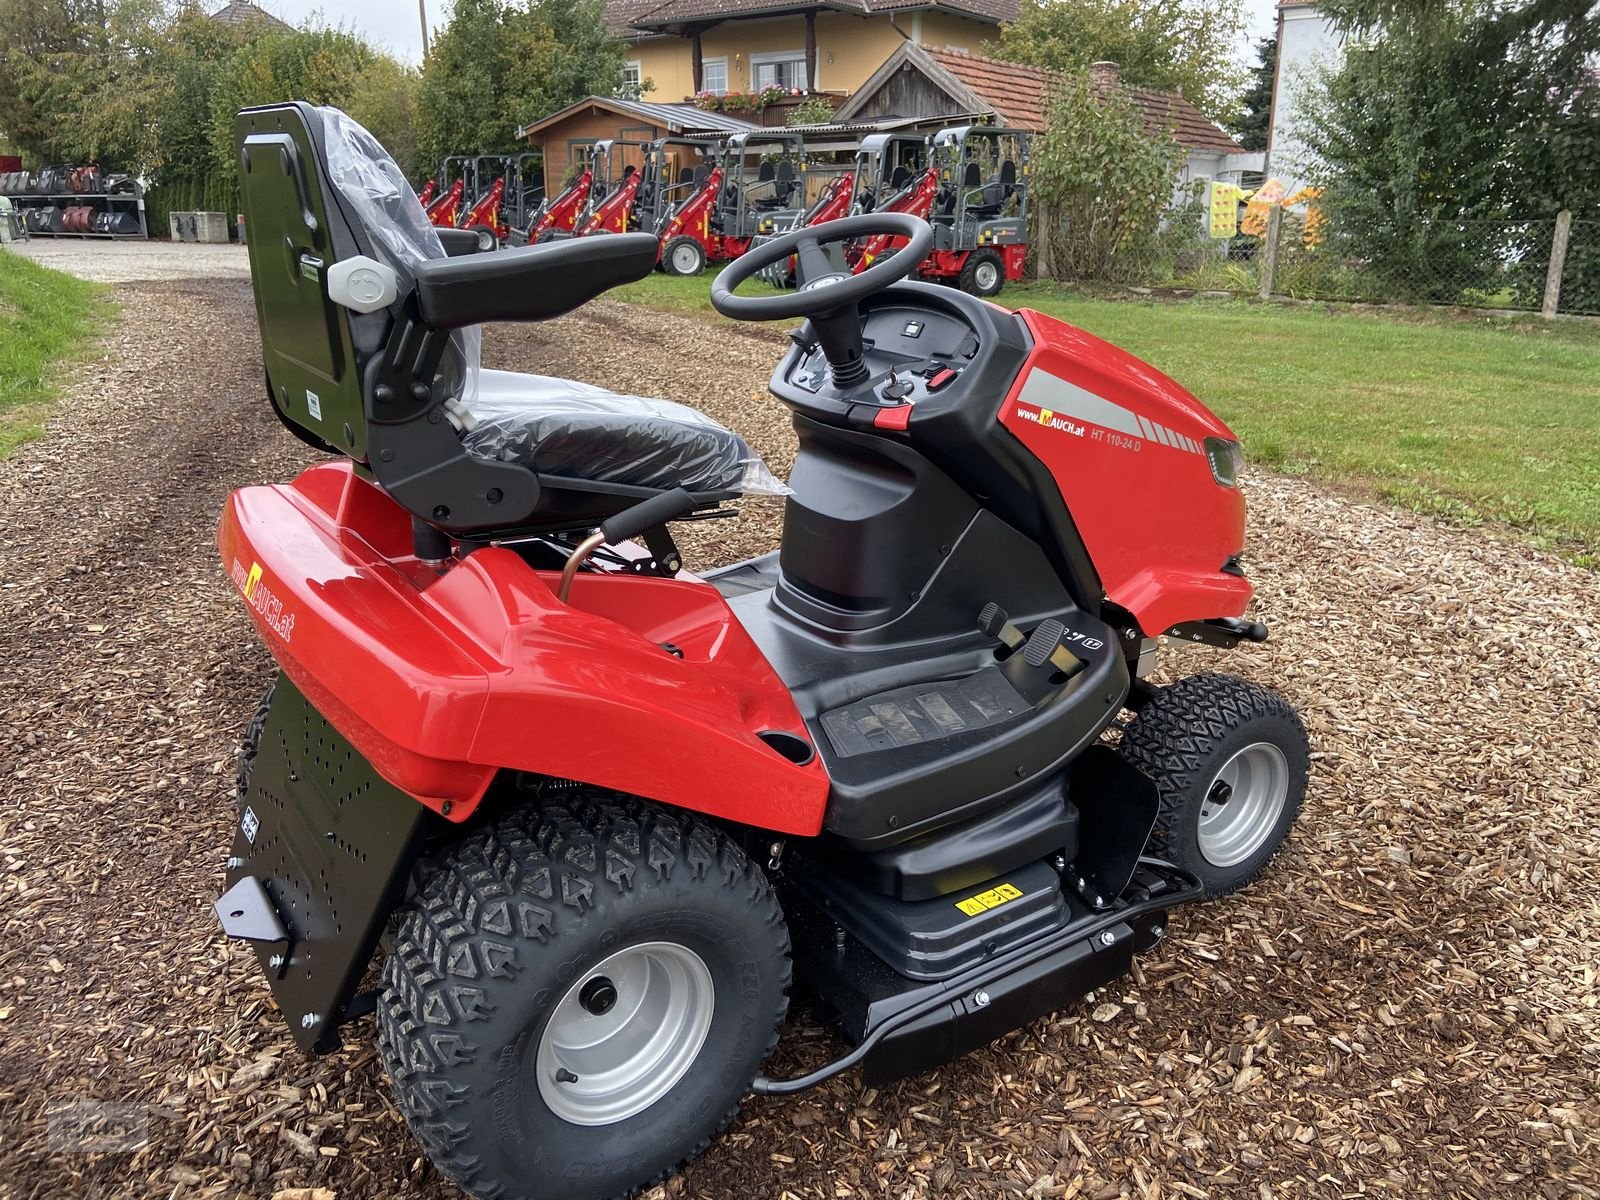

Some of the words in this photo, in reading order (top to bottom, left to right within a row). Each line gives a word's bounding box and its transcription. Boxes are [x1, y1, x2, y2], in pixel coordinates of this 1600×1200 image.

[1017, 408, 1085, 437] www.MAUCH.at
[1091, 428, 1104, 441] HT
[1106, 432, 1133, 450] 110-24
[1134, 440, 1141, 452] D
[231, 557, 294, 642] www.MAUCH.at
